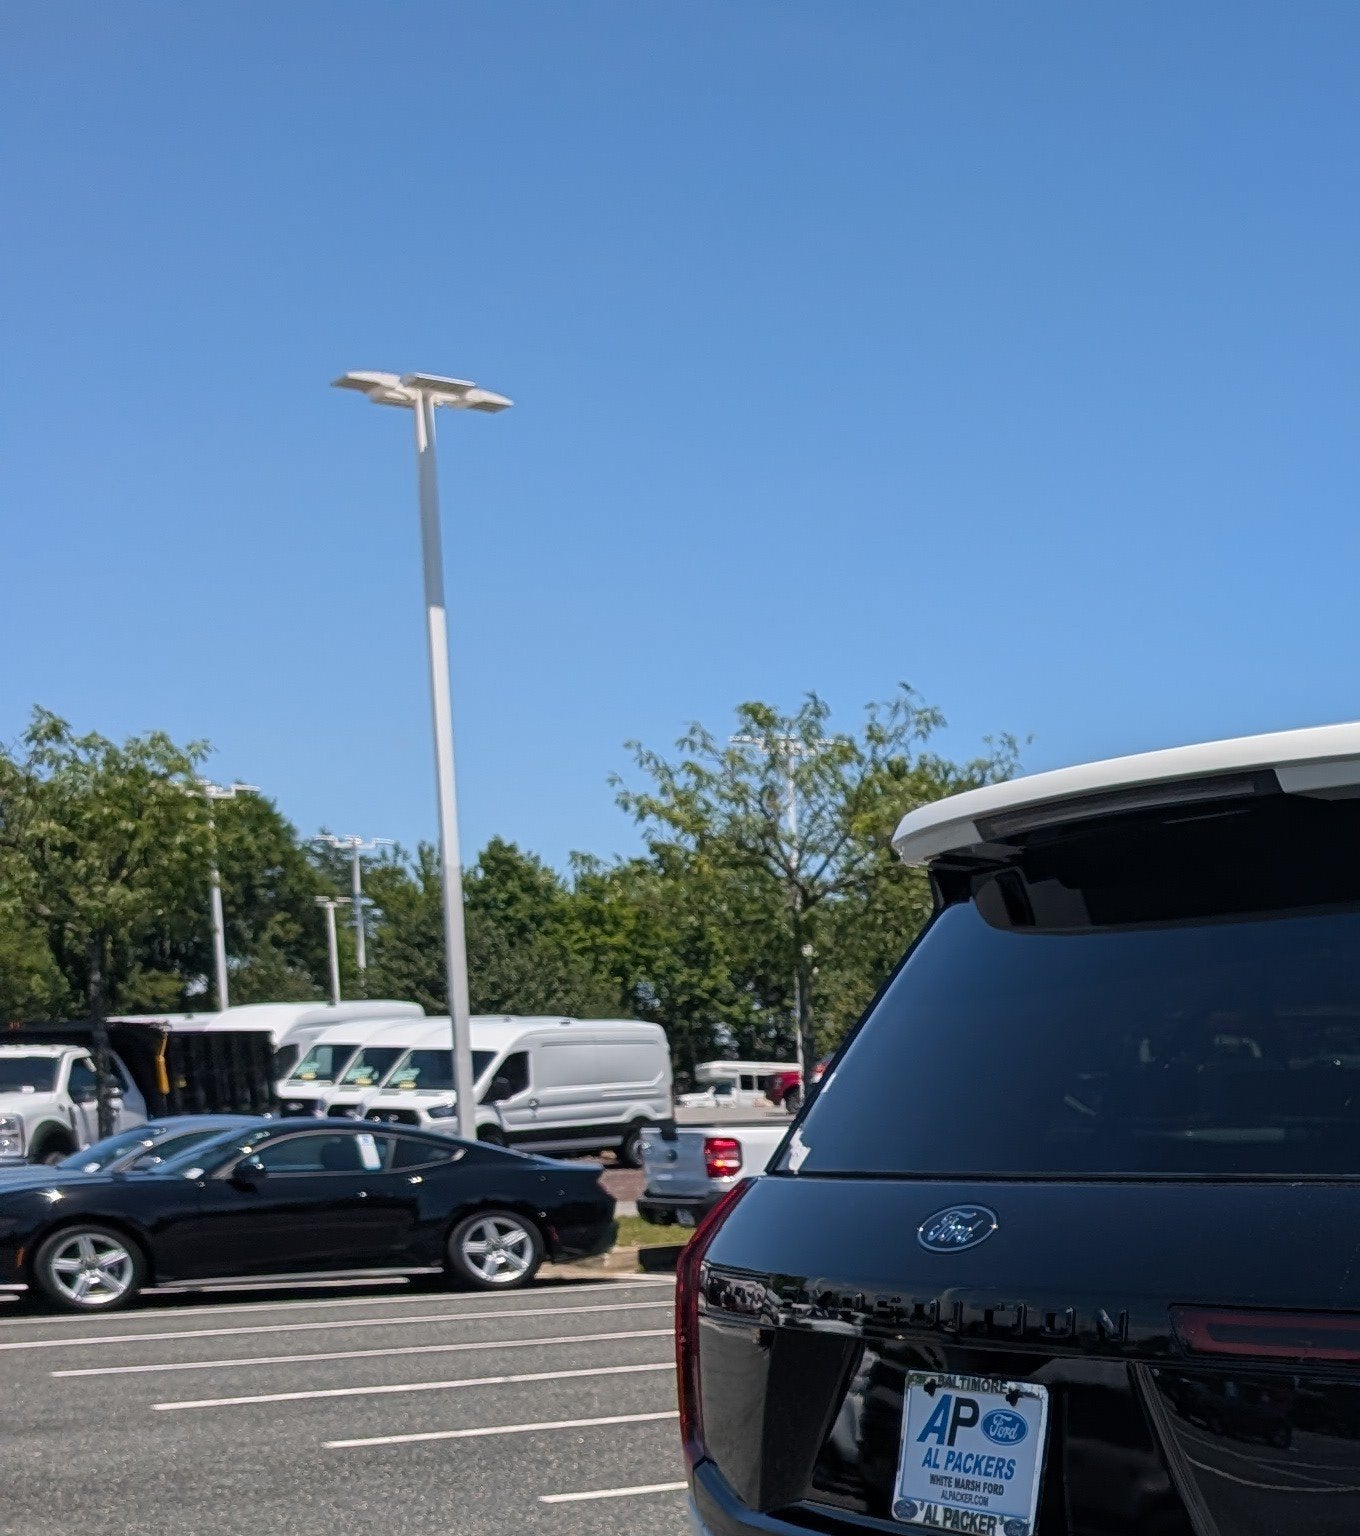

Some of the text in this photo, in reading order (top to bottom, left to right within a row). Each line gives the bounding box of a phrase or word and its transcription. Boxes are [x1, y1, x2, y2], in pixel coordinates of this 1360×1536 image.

[927, 1210, 984, 1243] Ford
[938, 1374, 1009, 1394] BALTIMORE
[916, 1394, 1018, 1447] AP Ford
[921, 1447, 1017, 1481] AL PACKERS
[930, 1473, 1005, 1496] WHITE MARSH FORD
[941, 1489, 989, 1507] ALPACKER.COM
